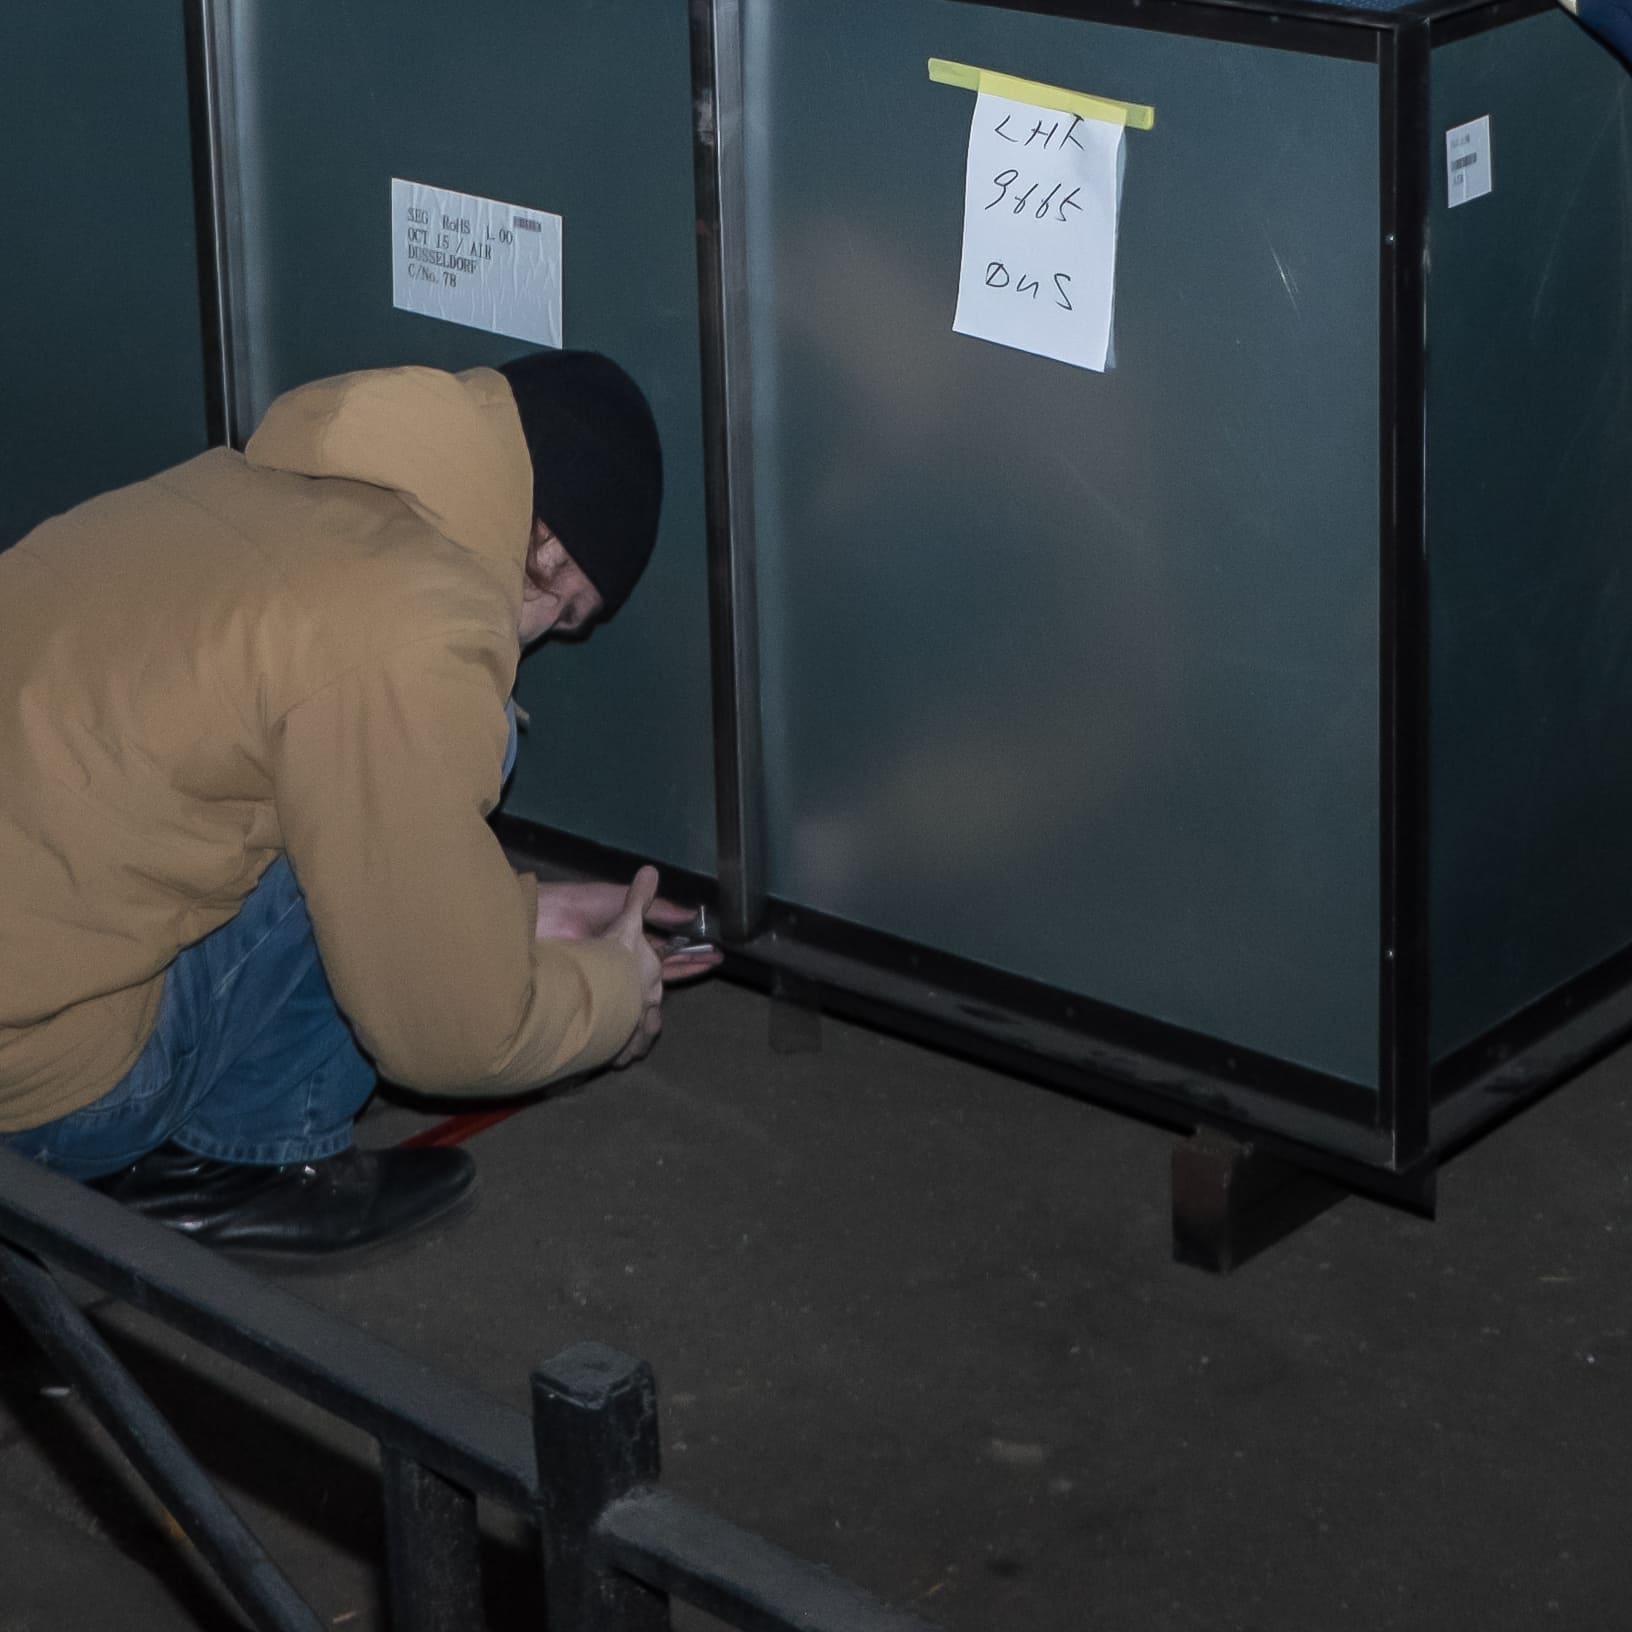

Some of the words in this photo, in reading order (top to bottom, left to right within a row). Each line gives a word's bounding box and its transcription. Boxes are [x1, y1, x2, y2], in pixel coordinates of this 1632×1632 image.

[984, 169, 1084, 222] 9665
[407, 208, 429, 225] SEG
[442, 215, 471, 234] RoHS
[407, 228, 428, 245] OCT
[436, 233, 450, 249] 15
[470, 242, 492, 260] AIR
[407, 244, 477, 274] DUSSELDORF
